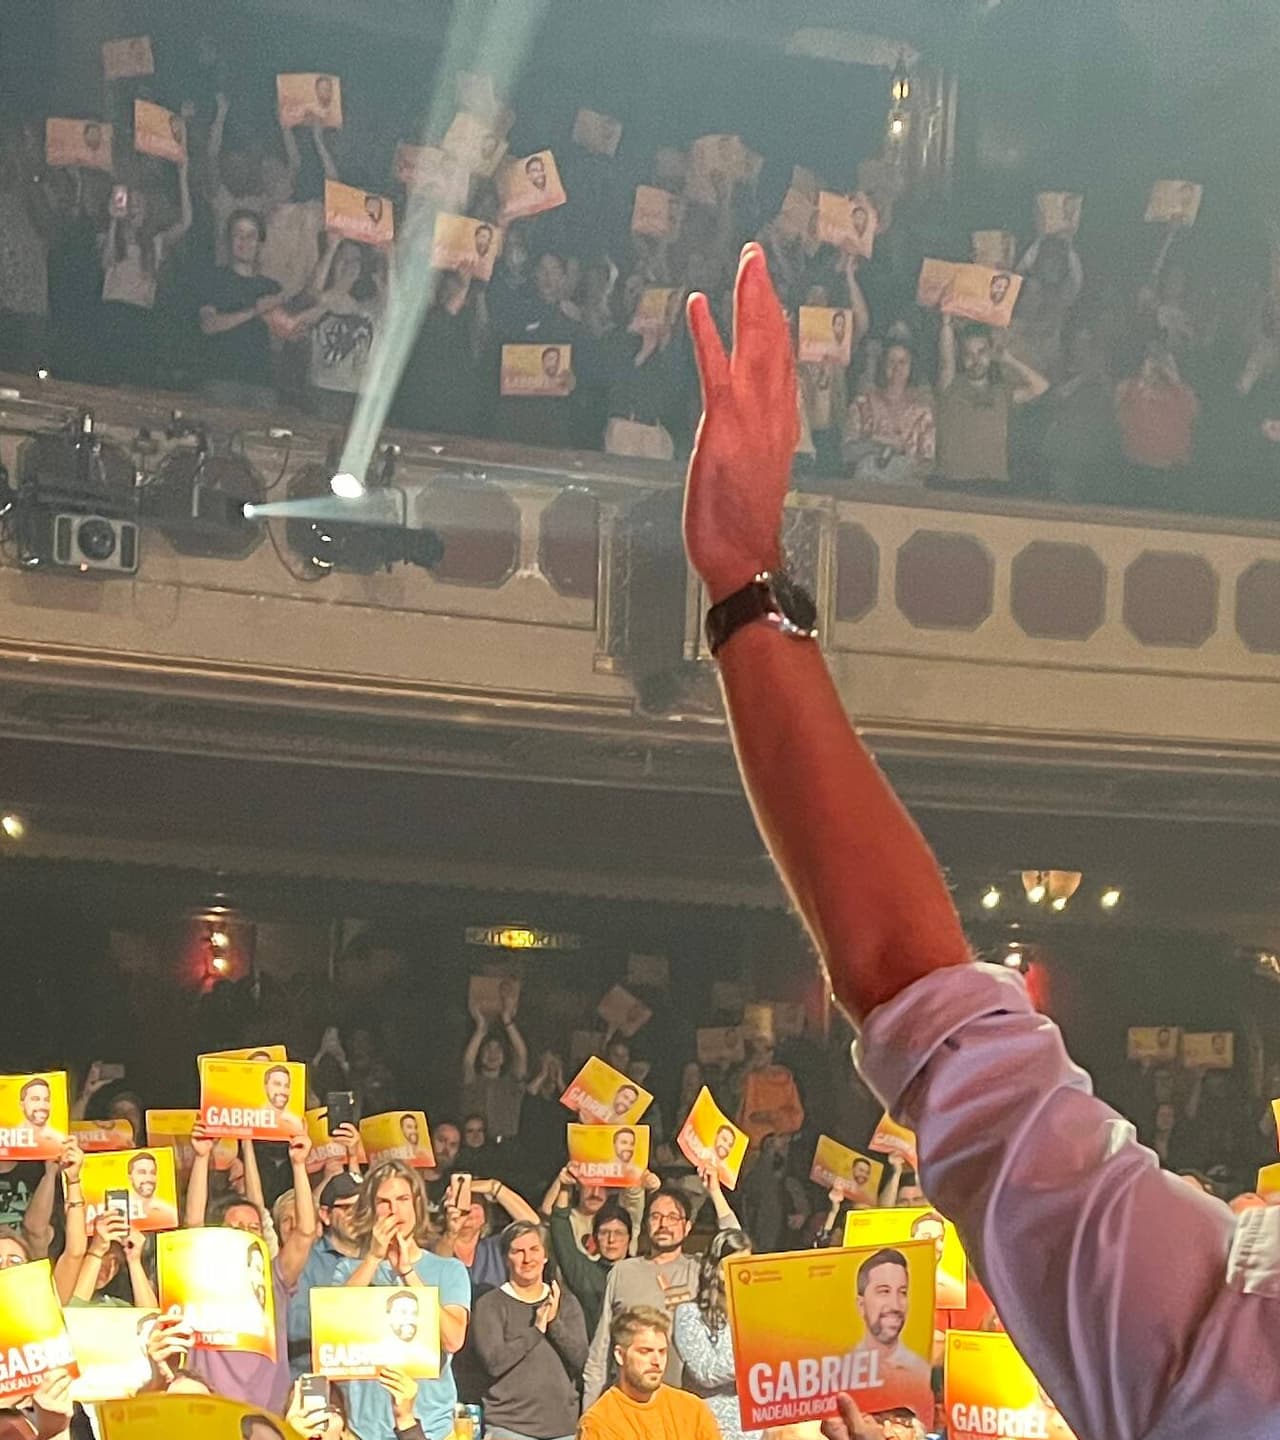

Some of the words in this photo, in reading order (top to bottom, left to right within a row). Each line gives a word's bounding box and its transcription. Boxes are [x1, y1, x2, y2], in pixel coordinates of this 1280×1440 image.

[206, 1106, 278, 1129] GABRIEL
[748, 1350, 884, 1405] GABRIEL
[952, 1403, 1049, 1439] GABRIEL
